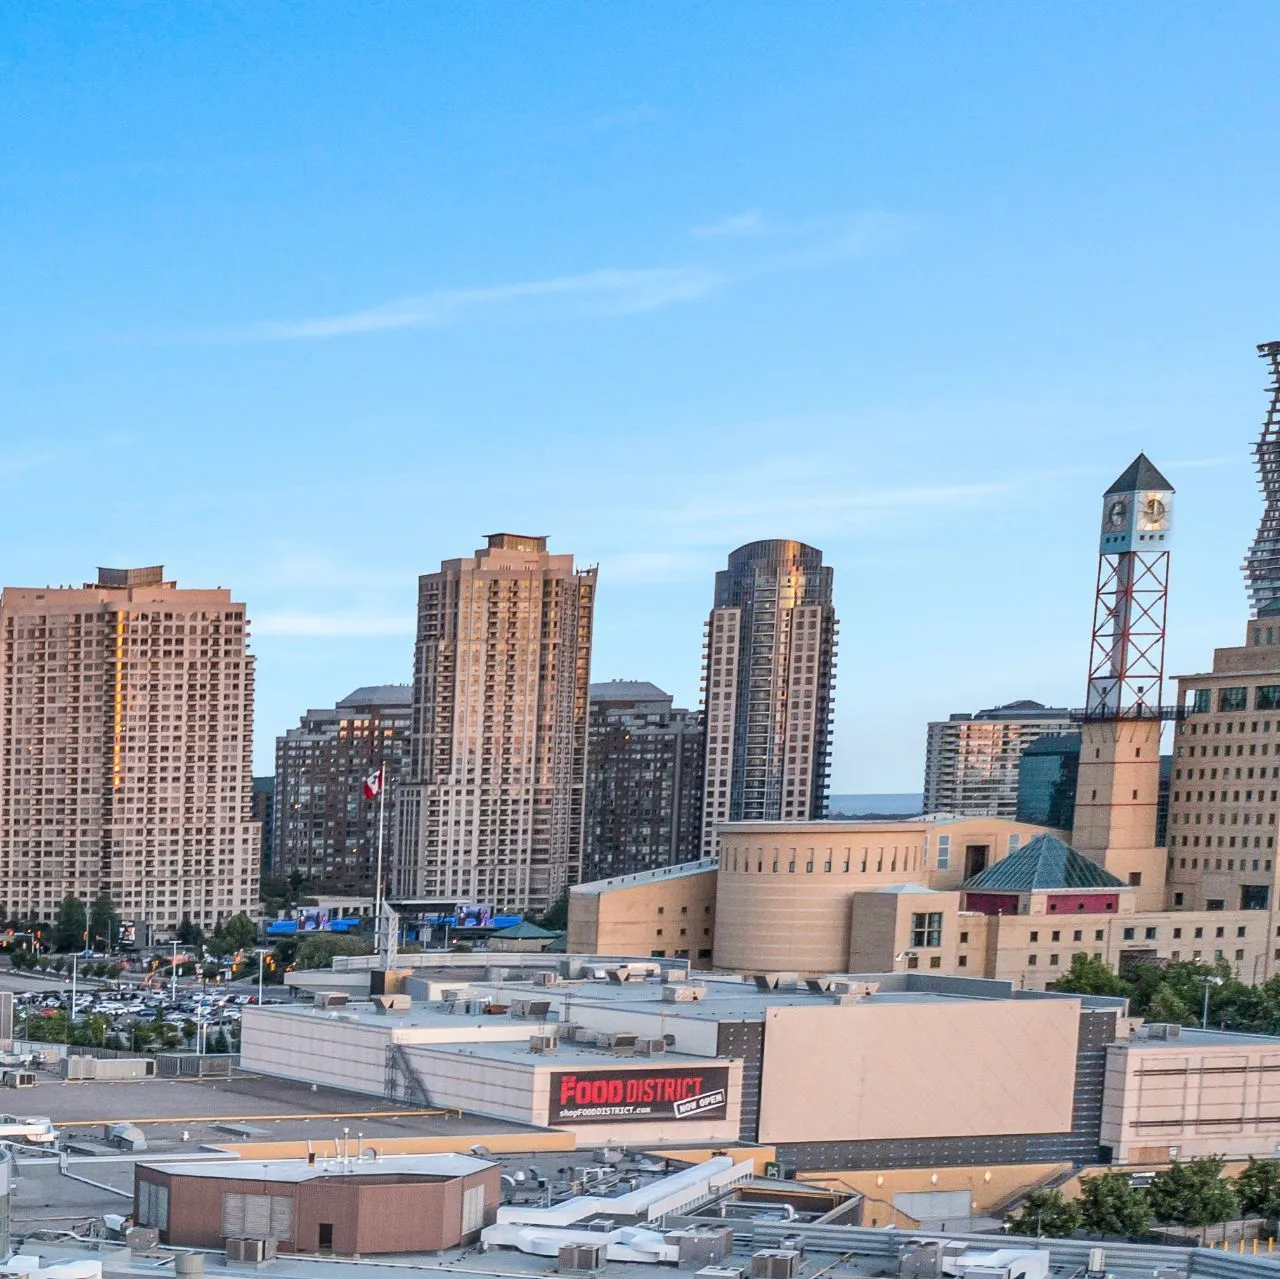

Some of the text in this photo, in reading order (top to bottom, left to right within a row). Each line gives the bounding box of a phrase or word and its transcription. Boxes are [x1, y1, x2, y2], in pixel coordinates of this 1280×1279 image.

[560, 1076, 704, 1105] FOOD DISTRICT
[679, 1093, 723, 1114] NOW OPEN
